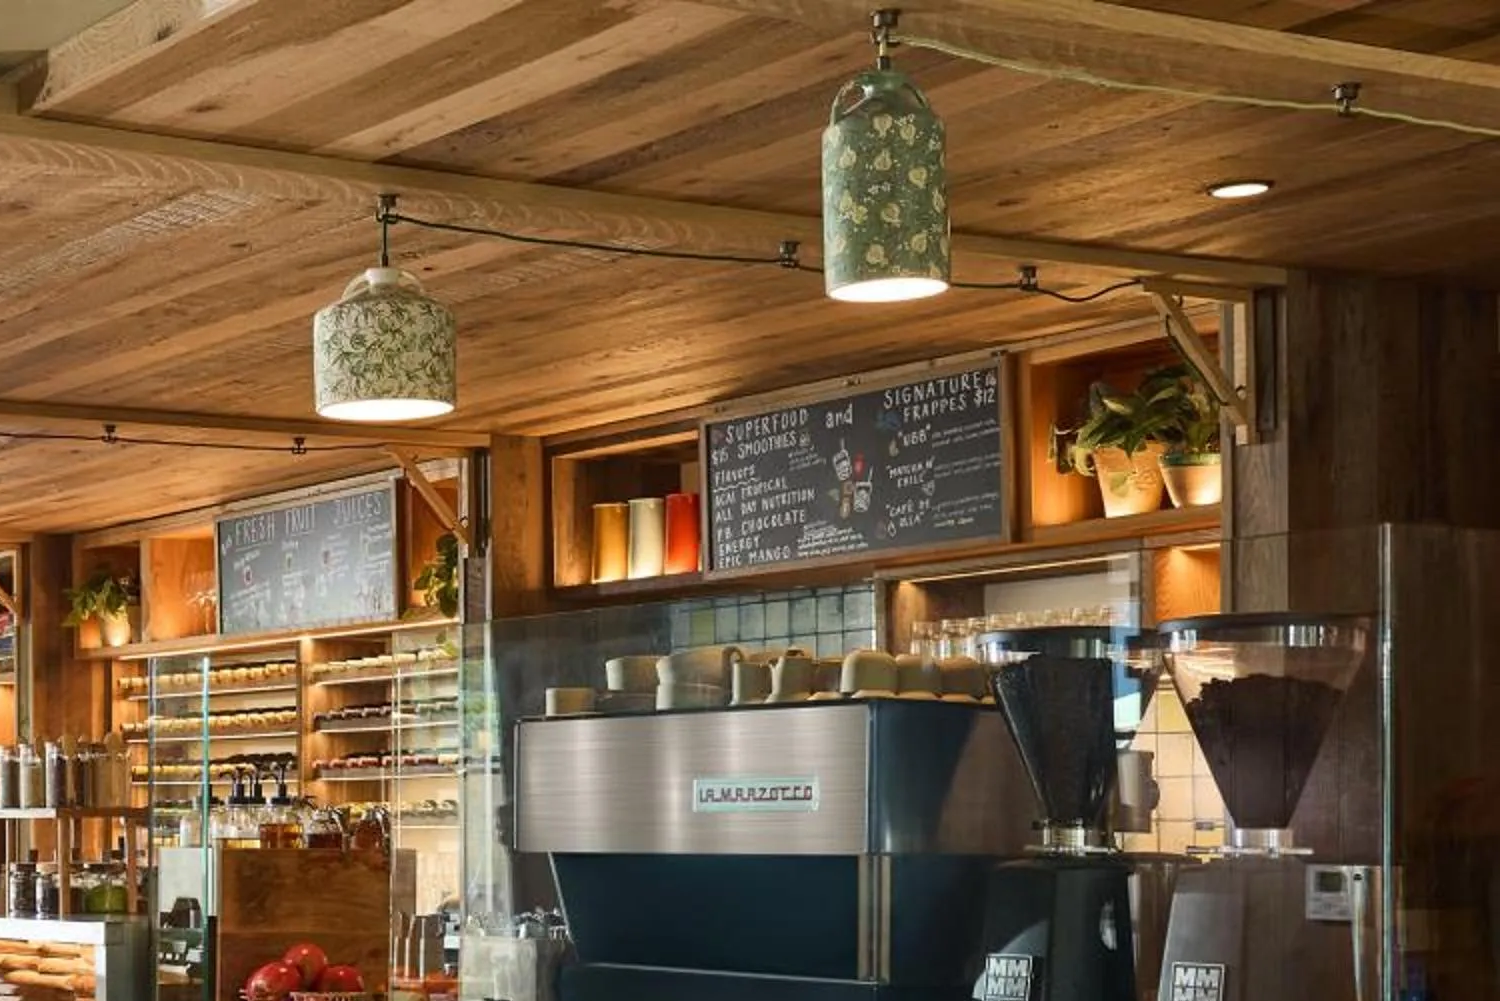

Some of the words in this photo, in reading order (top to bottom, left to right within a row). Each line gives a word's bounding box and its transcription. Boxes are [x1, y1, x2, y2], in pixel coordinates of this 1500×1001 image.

[883, 371, 981, 409] SIGNATURE
[903, 393, 968, 422] FRAPPES
[973, 387, 996, 408] $12
[726, 408, 808, 444] SUPERFOOD
[825, 403, 853, 429] and
[737, 431, 797, 459] SMOOTHIES
[235, 511, 275, 546] FRESH
[741, 509, 805, 537] CHOCOLATE
[750, 546, 791, 565] MANGO
